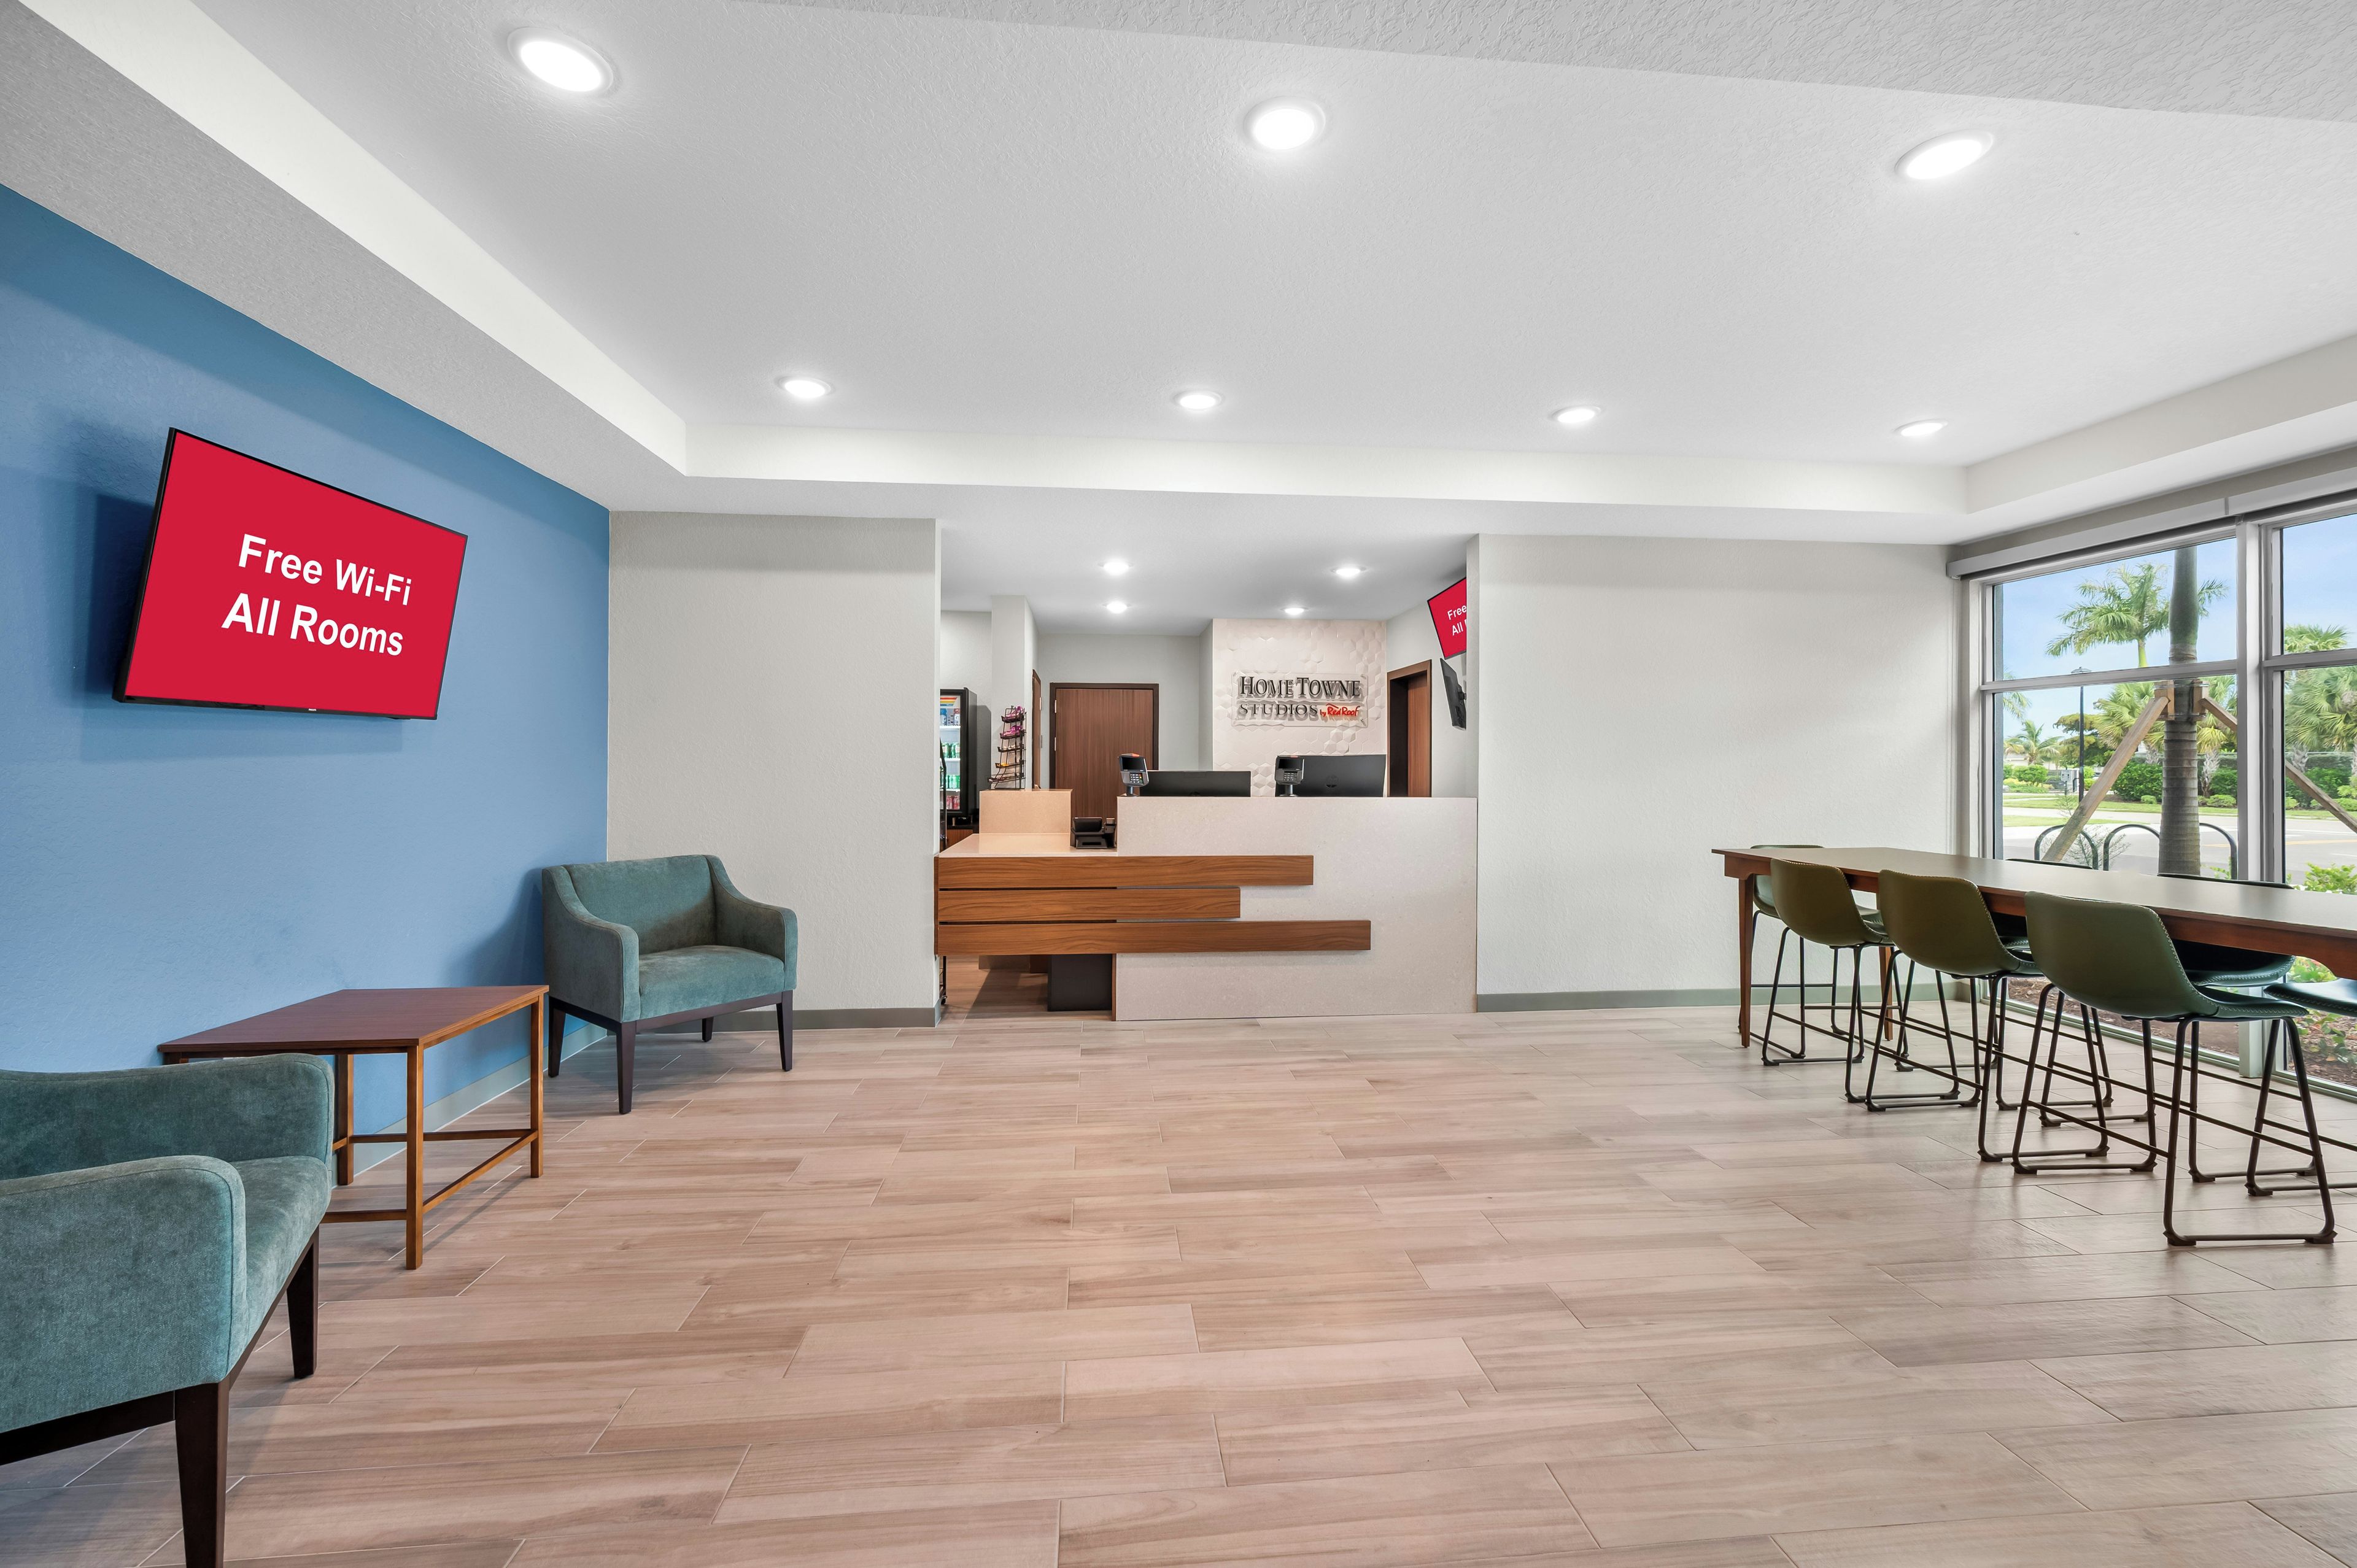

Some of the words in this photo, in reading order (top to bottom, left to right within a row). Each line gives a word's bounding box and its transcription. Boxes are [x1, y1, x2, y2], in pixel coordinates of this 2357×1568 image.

[238, 533, 322, 584] Free
[336, 558, 412, 606] Wi-Fi
[1447, 605, 1466, 620] Free
[221, 593, 281, 636] All
[290, 604, 403, 656] Rooms
[1452, 622, 1463, 636] All
[1240, 703, 1317, 716] STUDIOS
